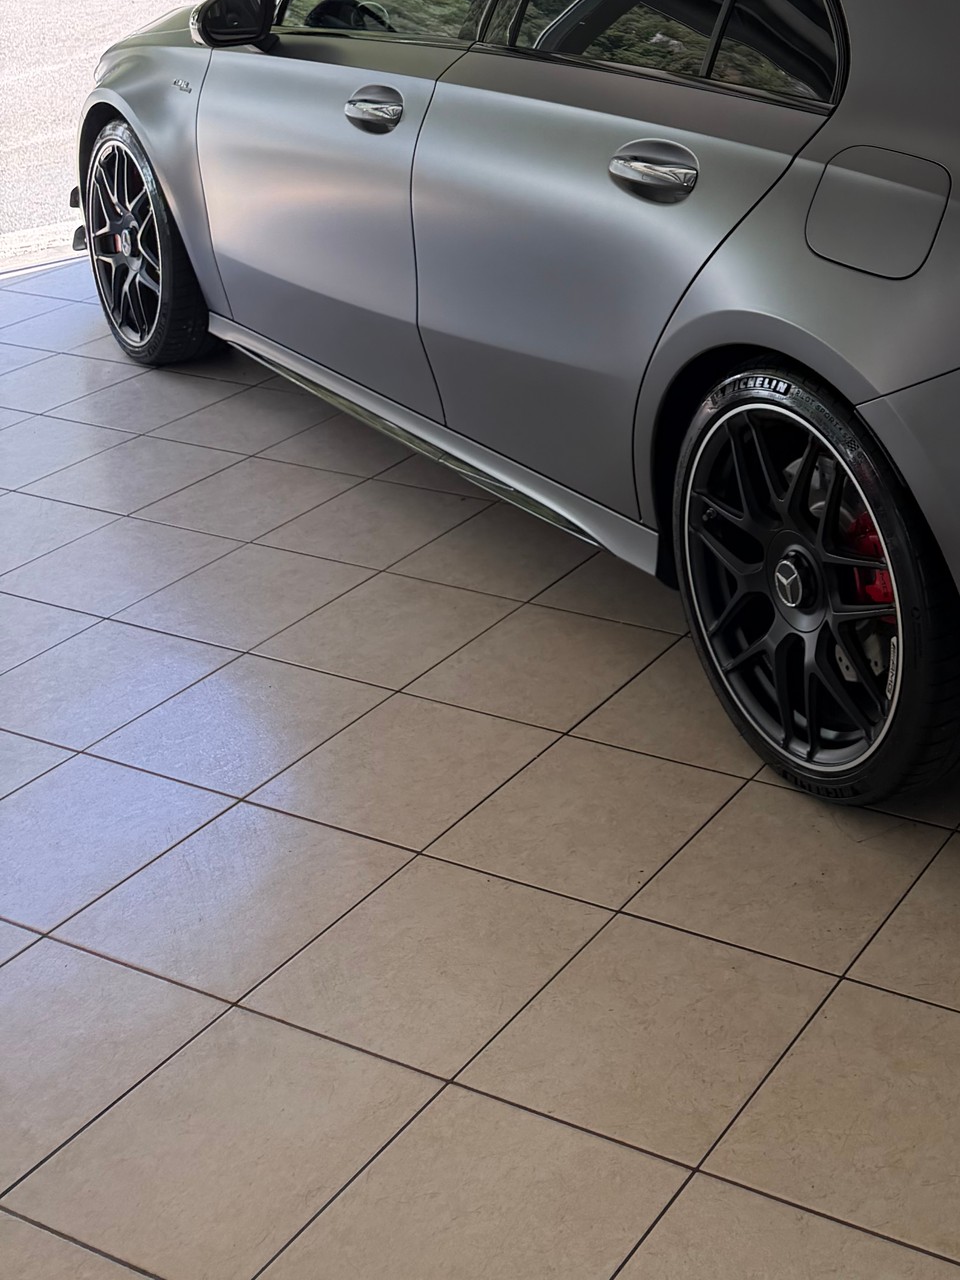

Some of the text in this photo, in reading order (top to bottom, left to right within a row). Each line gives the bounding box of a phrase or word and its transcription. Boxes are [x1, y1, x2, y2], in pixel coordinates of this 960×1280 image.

[725, 376, 788, 396] MICHELIN
[795, 388, 816, 406] PILOT
[815, 404, 840, 427] SPORT
